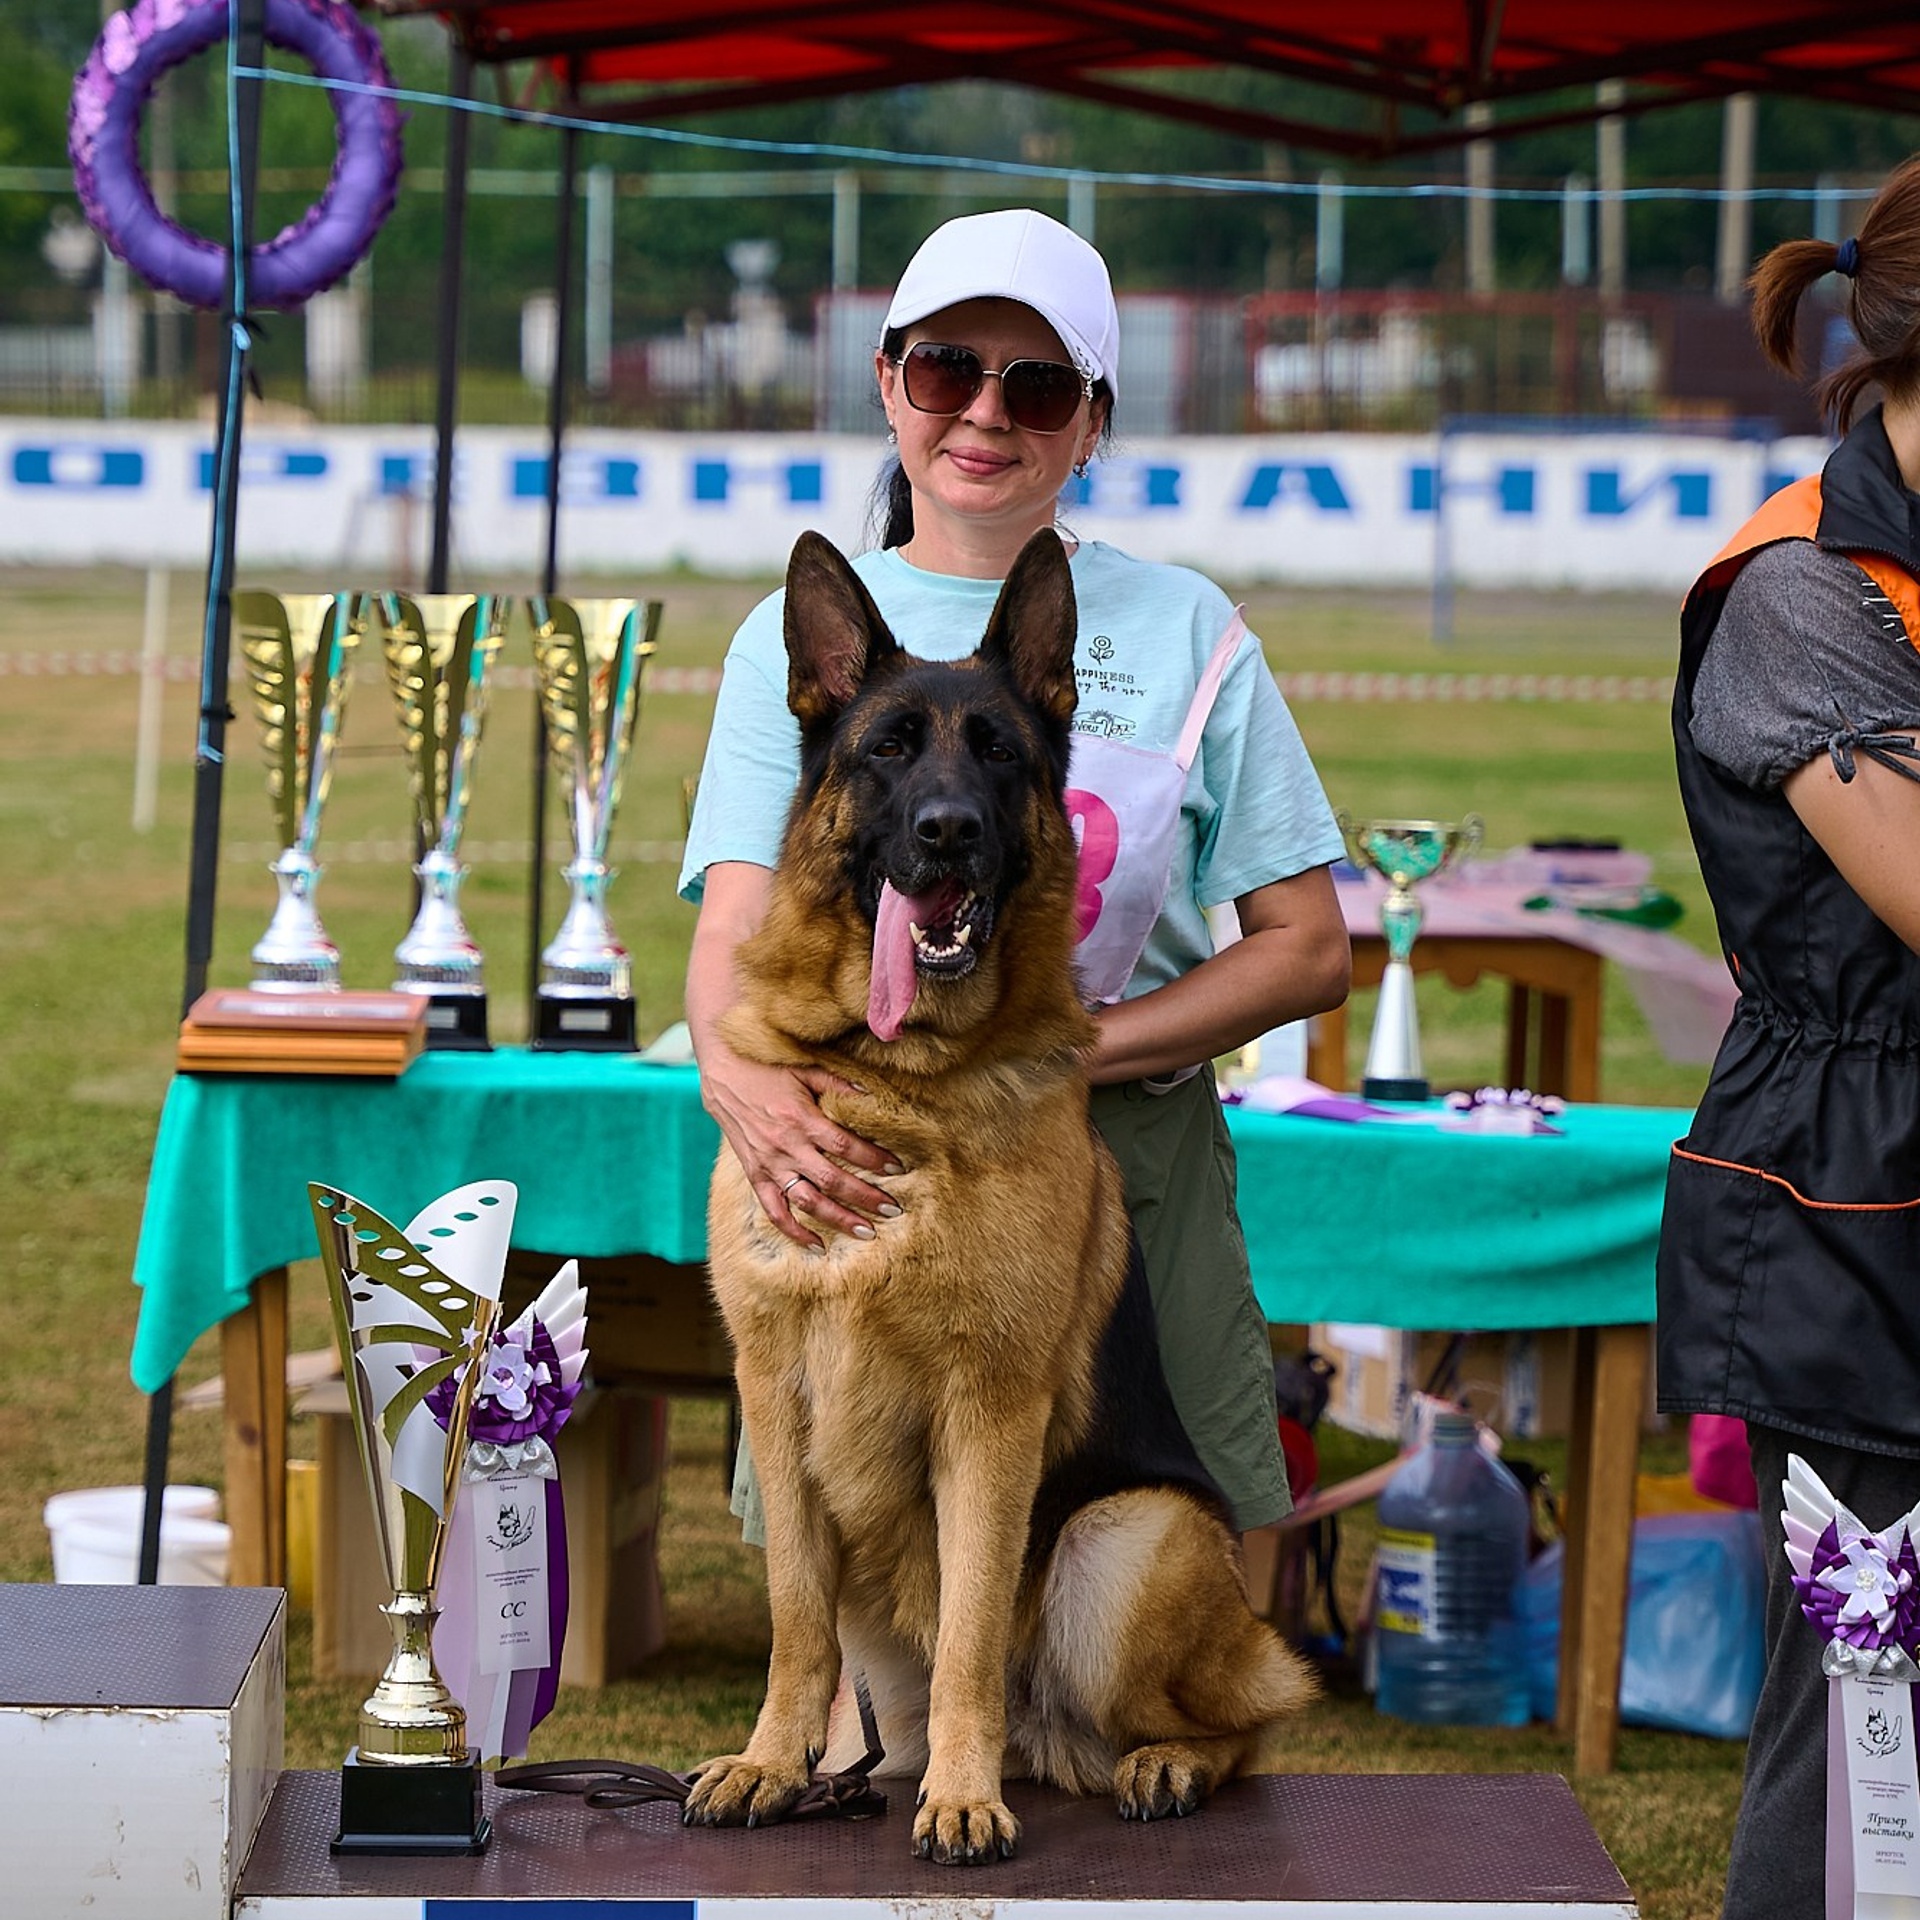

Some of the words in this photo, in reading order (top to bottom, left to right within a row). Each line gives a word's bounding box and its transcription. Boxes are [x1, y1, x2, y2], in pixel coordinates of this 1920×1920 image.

[1075, 668, 1135, 684] APPINESS
[1866, 1812, 1907, 1829] Призер
[1862, 1827, 1915, 1841] выставки
